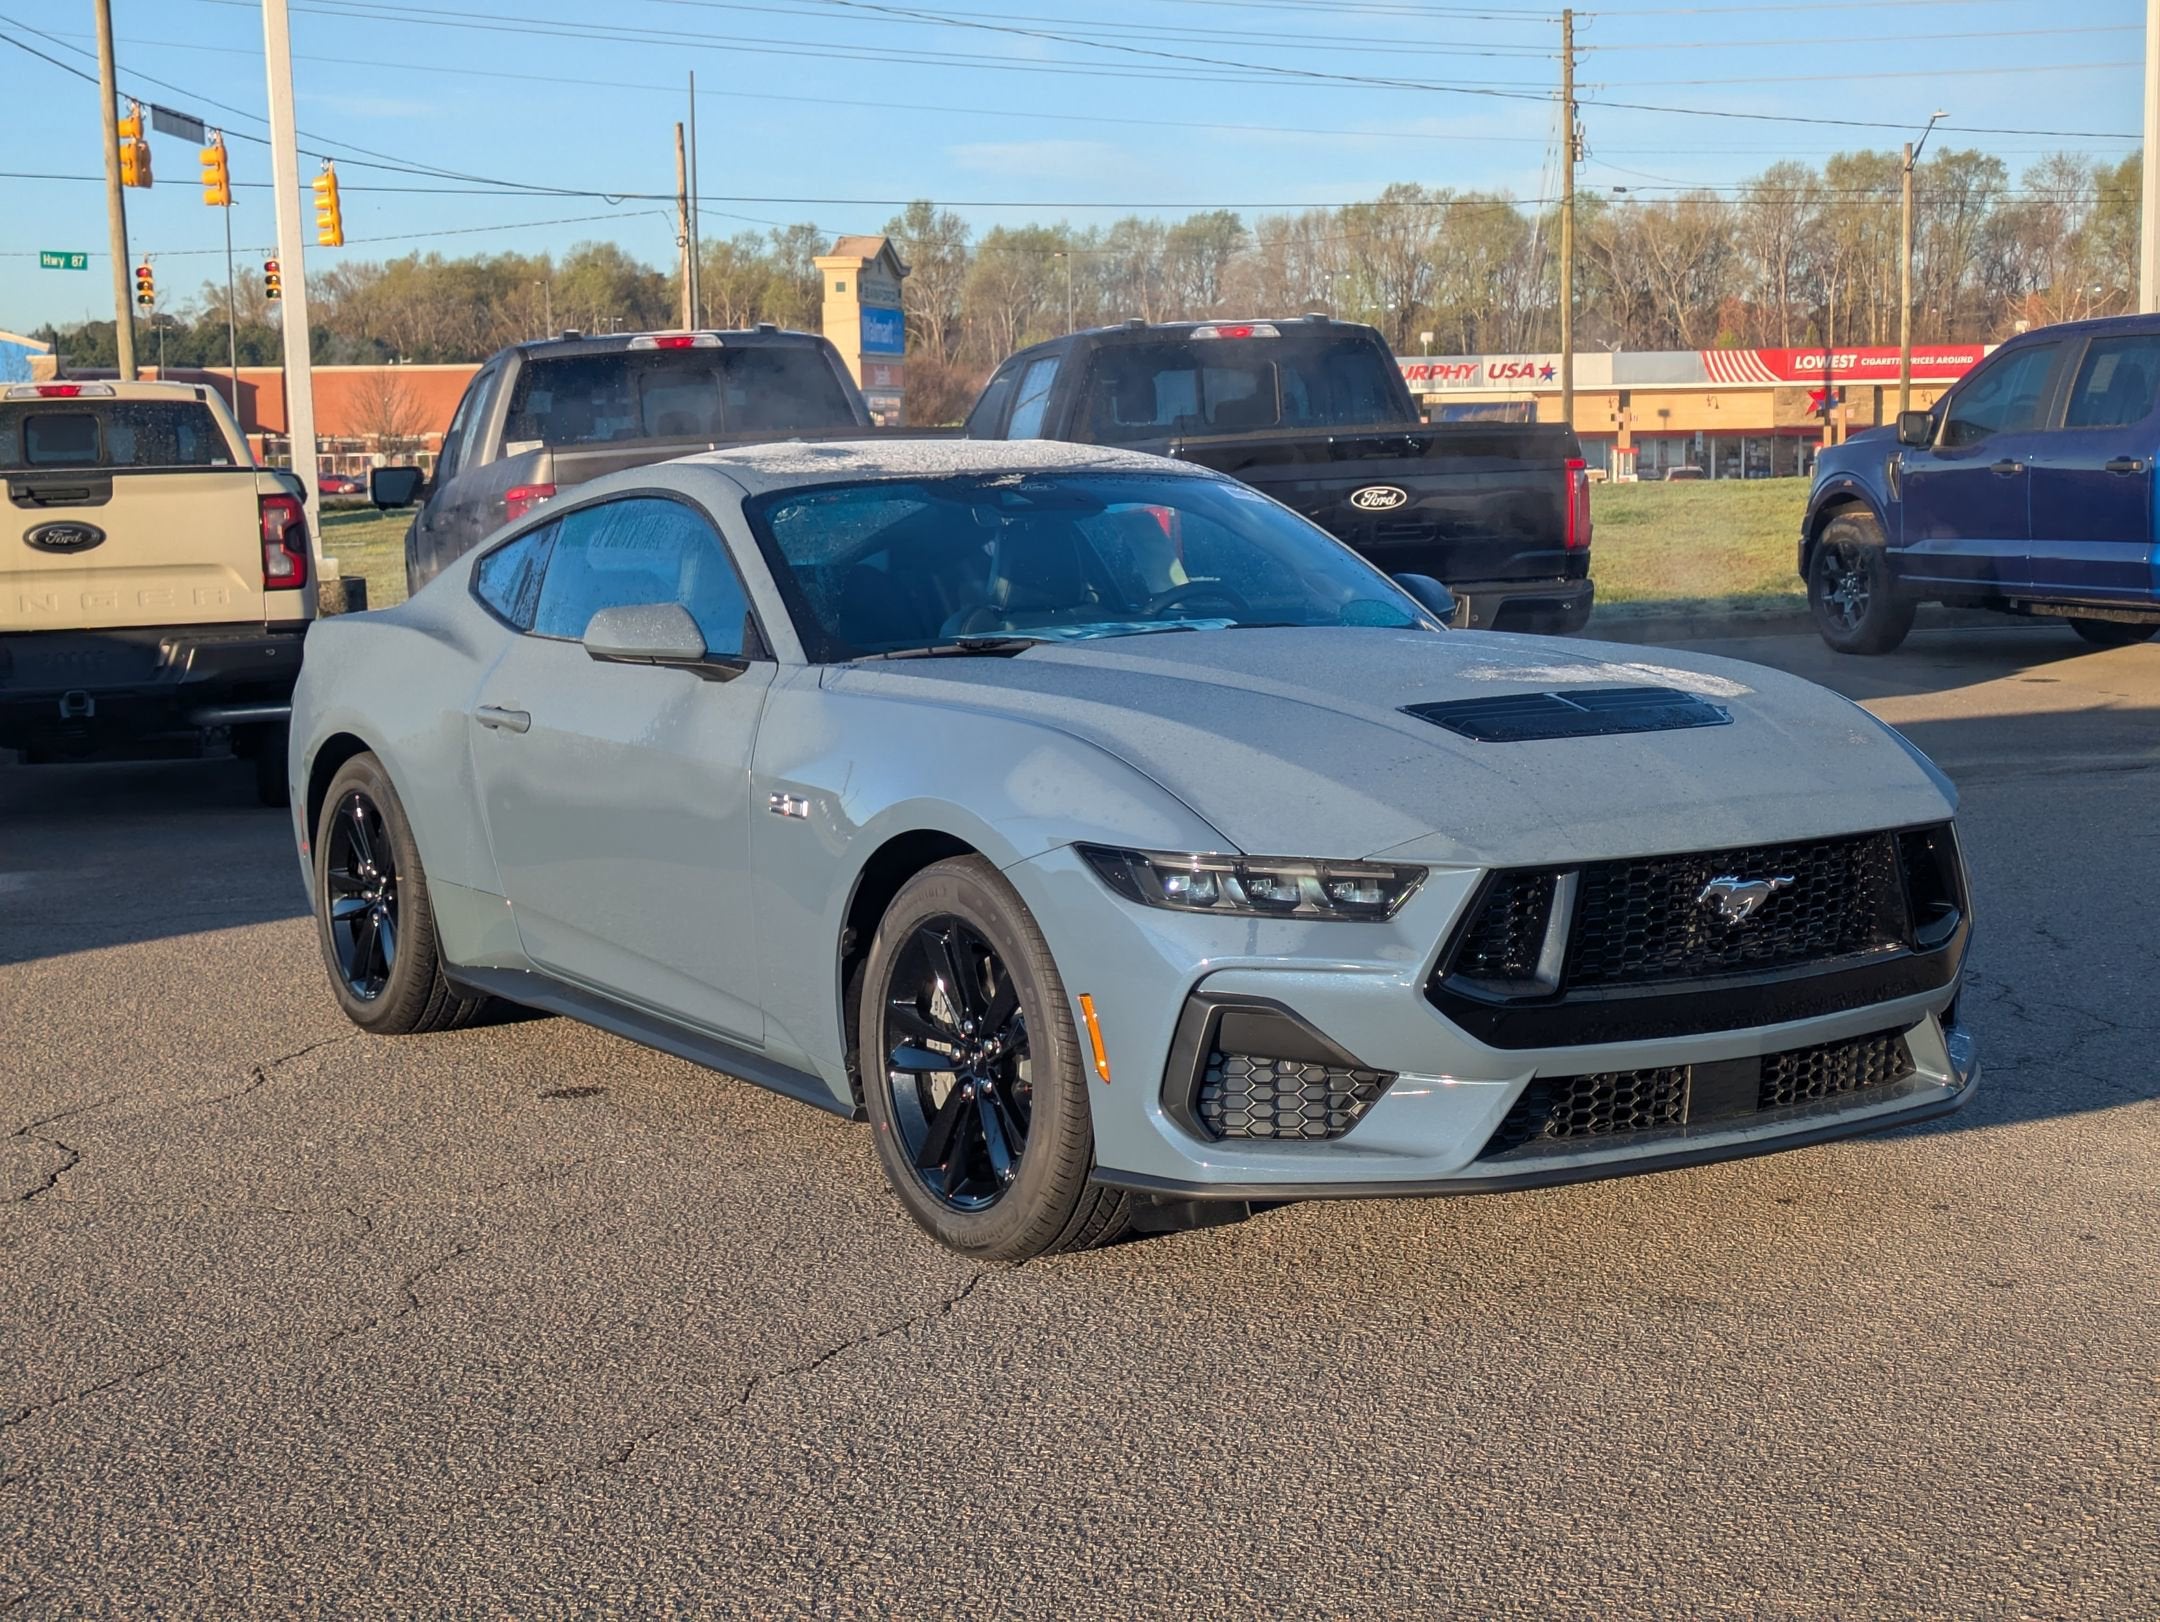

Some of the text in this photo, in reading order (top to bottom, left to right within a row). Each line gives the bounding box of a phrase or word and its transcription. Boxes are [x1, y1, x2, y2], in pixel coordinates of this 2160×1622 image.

[43, 254, 85, 268] Hwy 87
[1794, 354, 1974, 369] LOWEST CIGARETT RICES AROUND
[1399, 362, 1536, 380] URPHY USA
[1361, 489, 1397, 506] Ford
[45, 529, 83, 545] Ford
[0, 588, 230, 613] NGER
